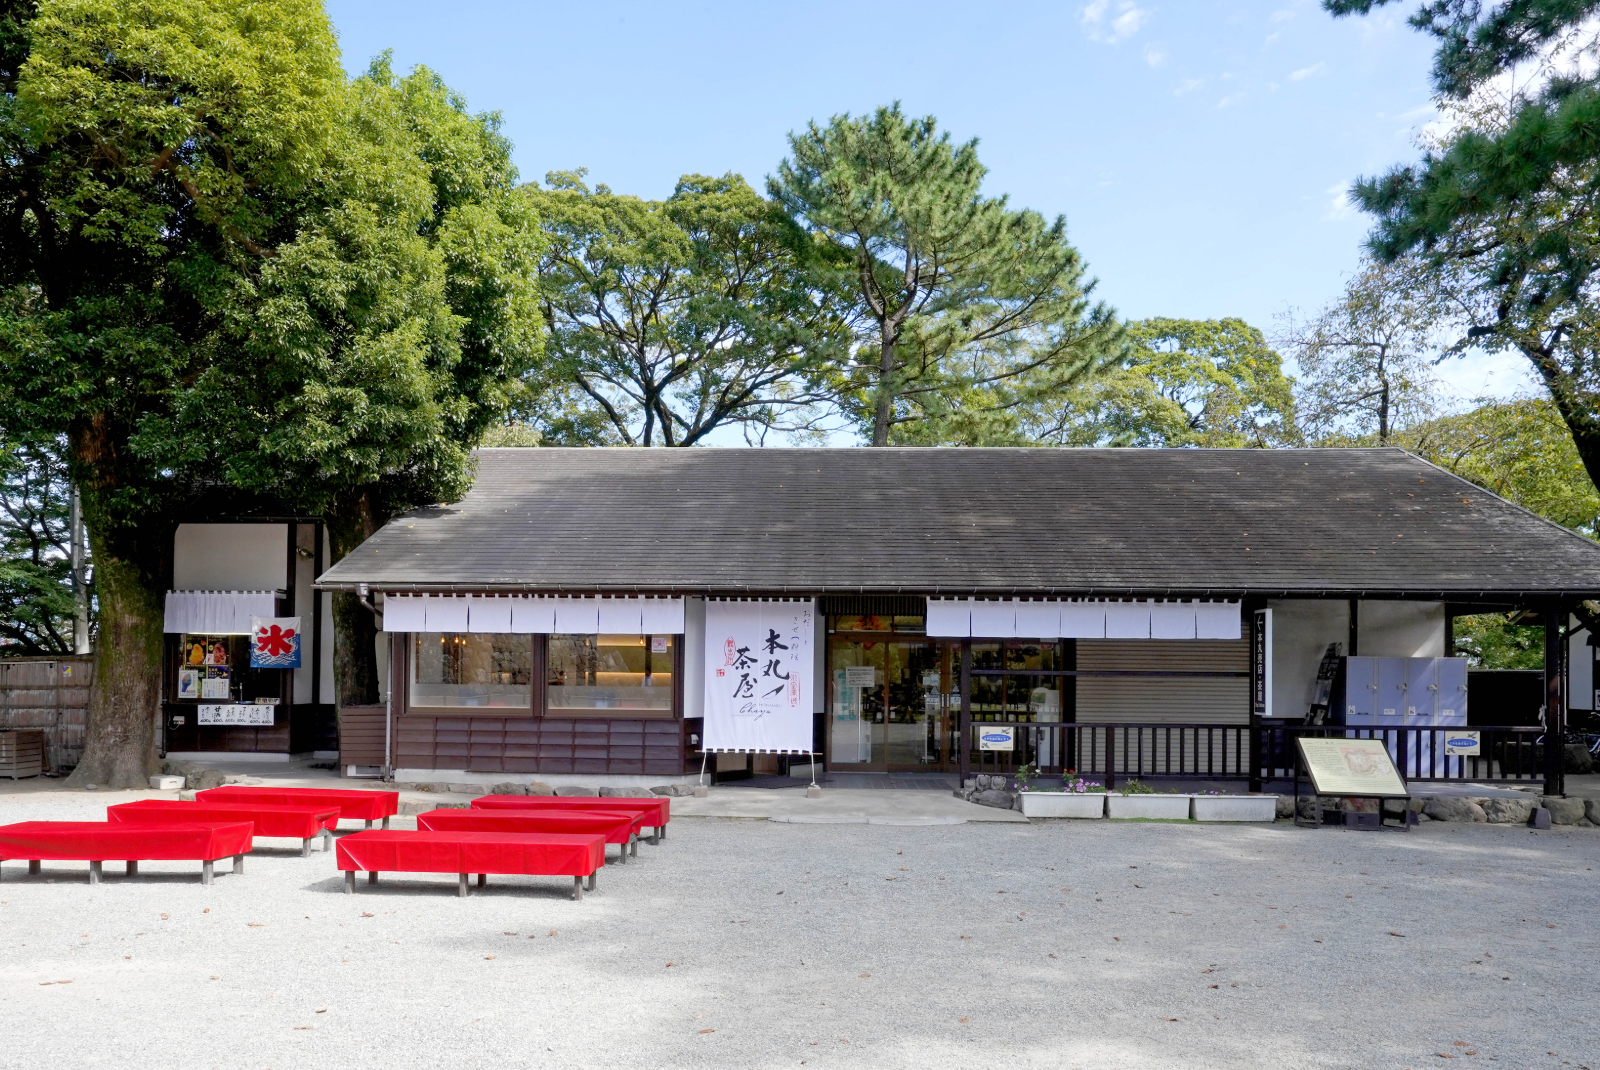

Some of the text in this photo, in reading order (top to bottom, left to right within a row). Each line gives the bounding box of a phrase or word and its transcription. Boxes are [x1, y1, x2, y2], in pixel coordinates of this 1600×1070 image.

[256, 624, 295, 657] 氷
[761, 628, 791, 681] 本丸
[732, 646, 759, 699] 茶屋
[739, 701, 772, 721] Chaya
